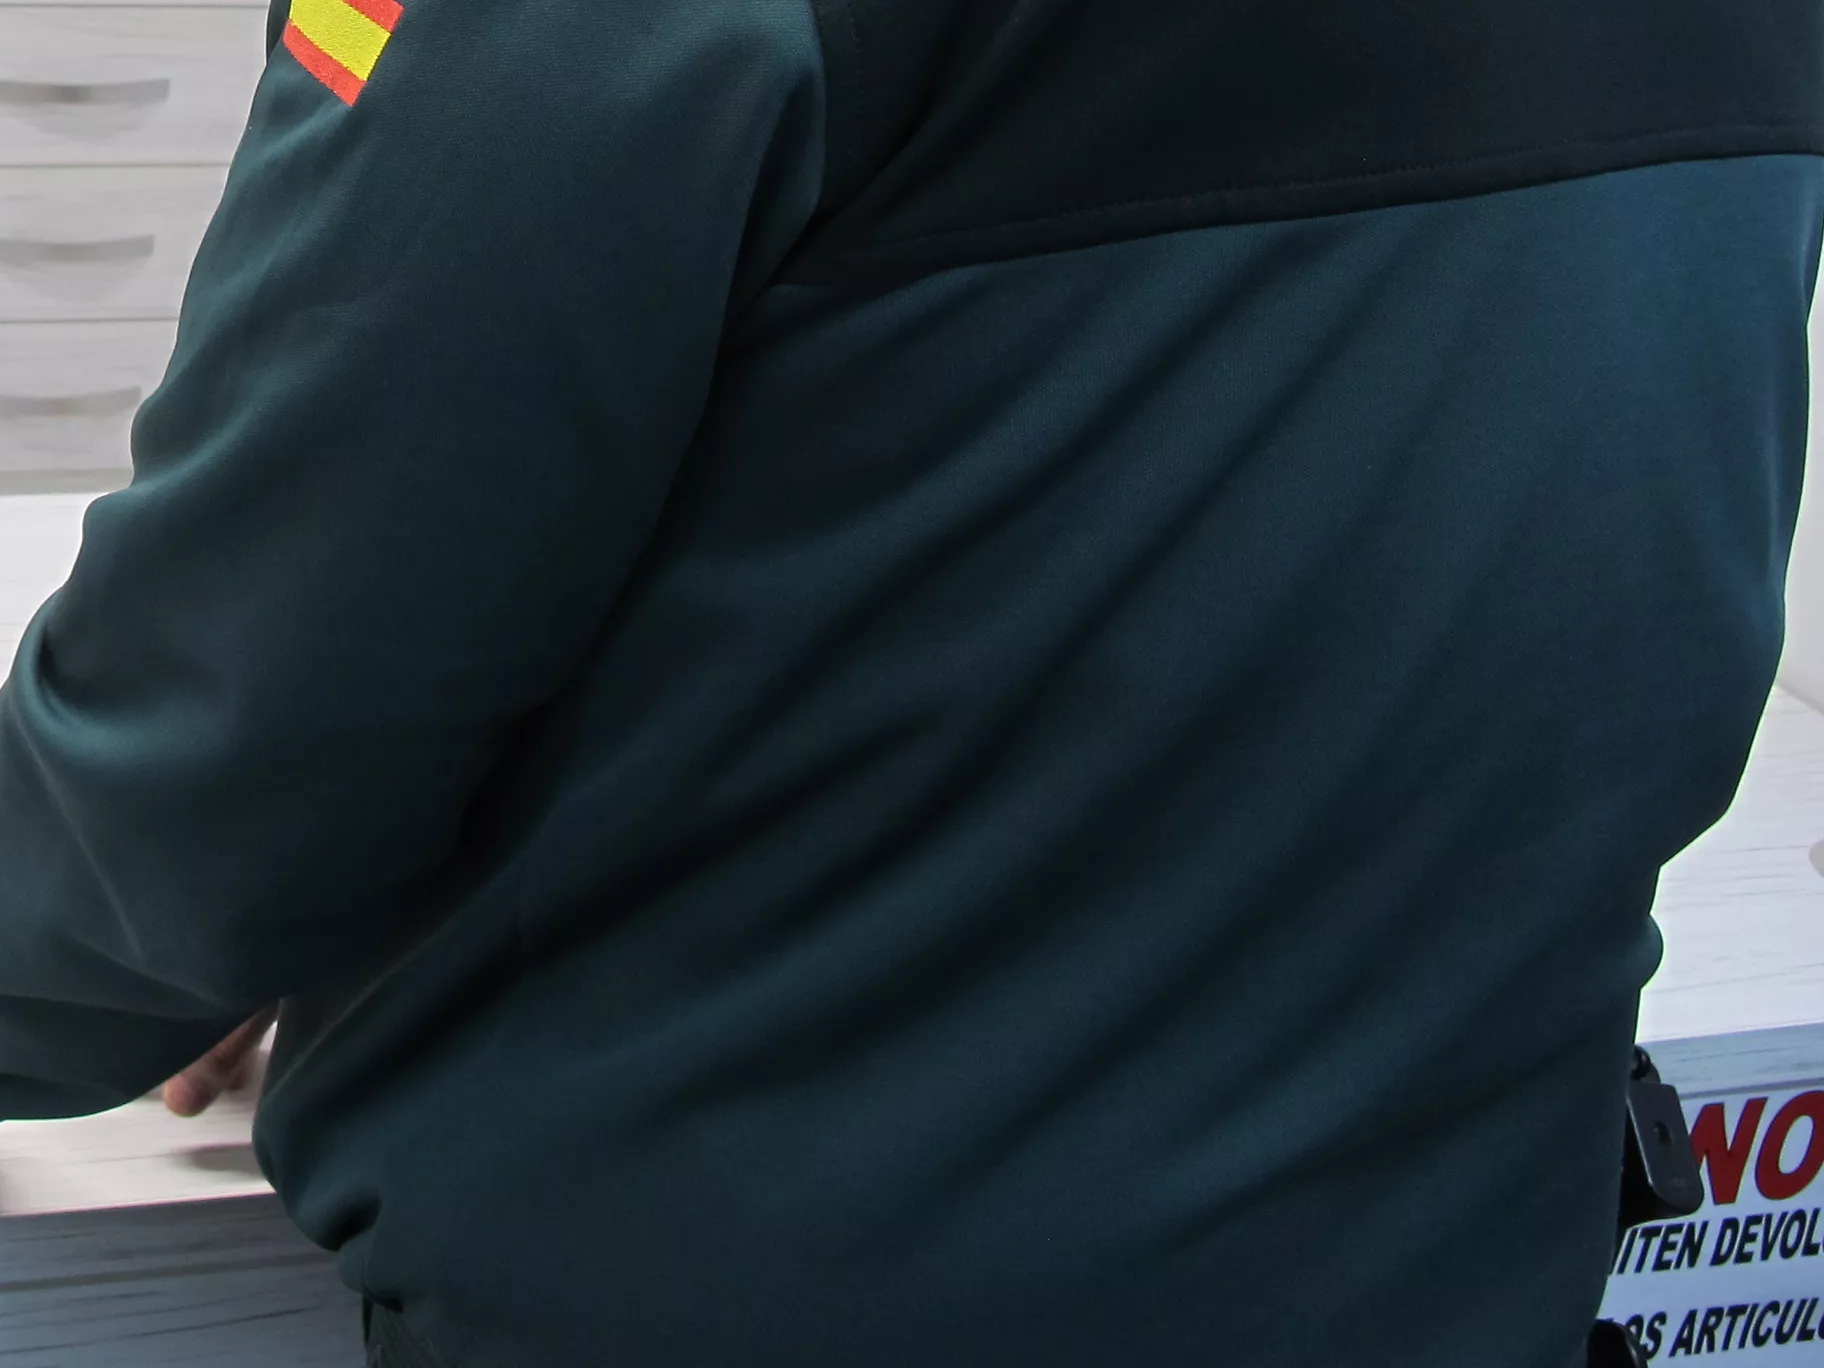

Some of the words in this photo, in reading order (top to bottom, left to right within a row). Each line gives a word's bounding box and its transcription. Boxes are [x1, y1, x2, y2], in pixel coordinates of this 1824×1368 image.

[1688, 1090, 1824, 1206] NO
[1709, 1208, 1824, 1267] DEVOL
[1668, 1297, 1824, 1359] ARTICUL
